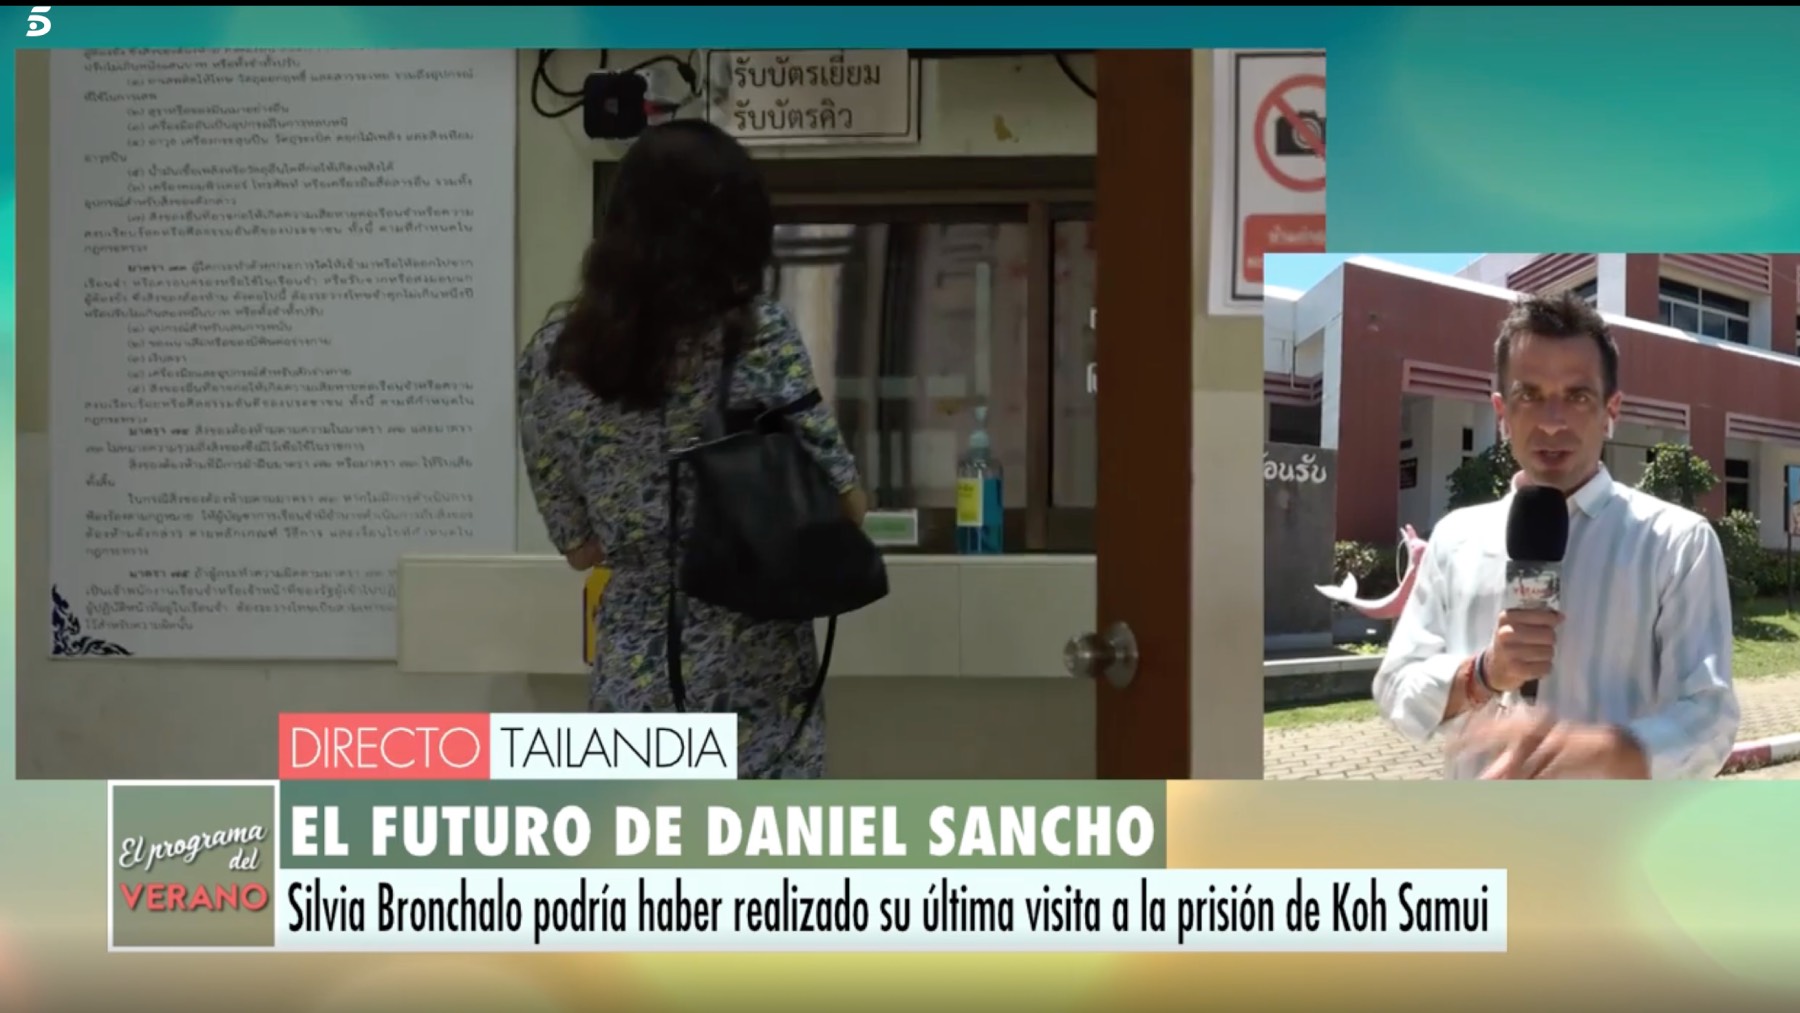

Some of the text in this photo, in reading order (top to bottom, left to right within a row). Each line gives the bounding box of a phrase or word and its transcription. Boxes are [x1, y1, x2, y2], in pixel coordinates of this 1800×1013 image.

[734, 54, 881, 89] รับบัตรเยี่ยม
[733, 98, 853, 131] รับบัตรคิว
